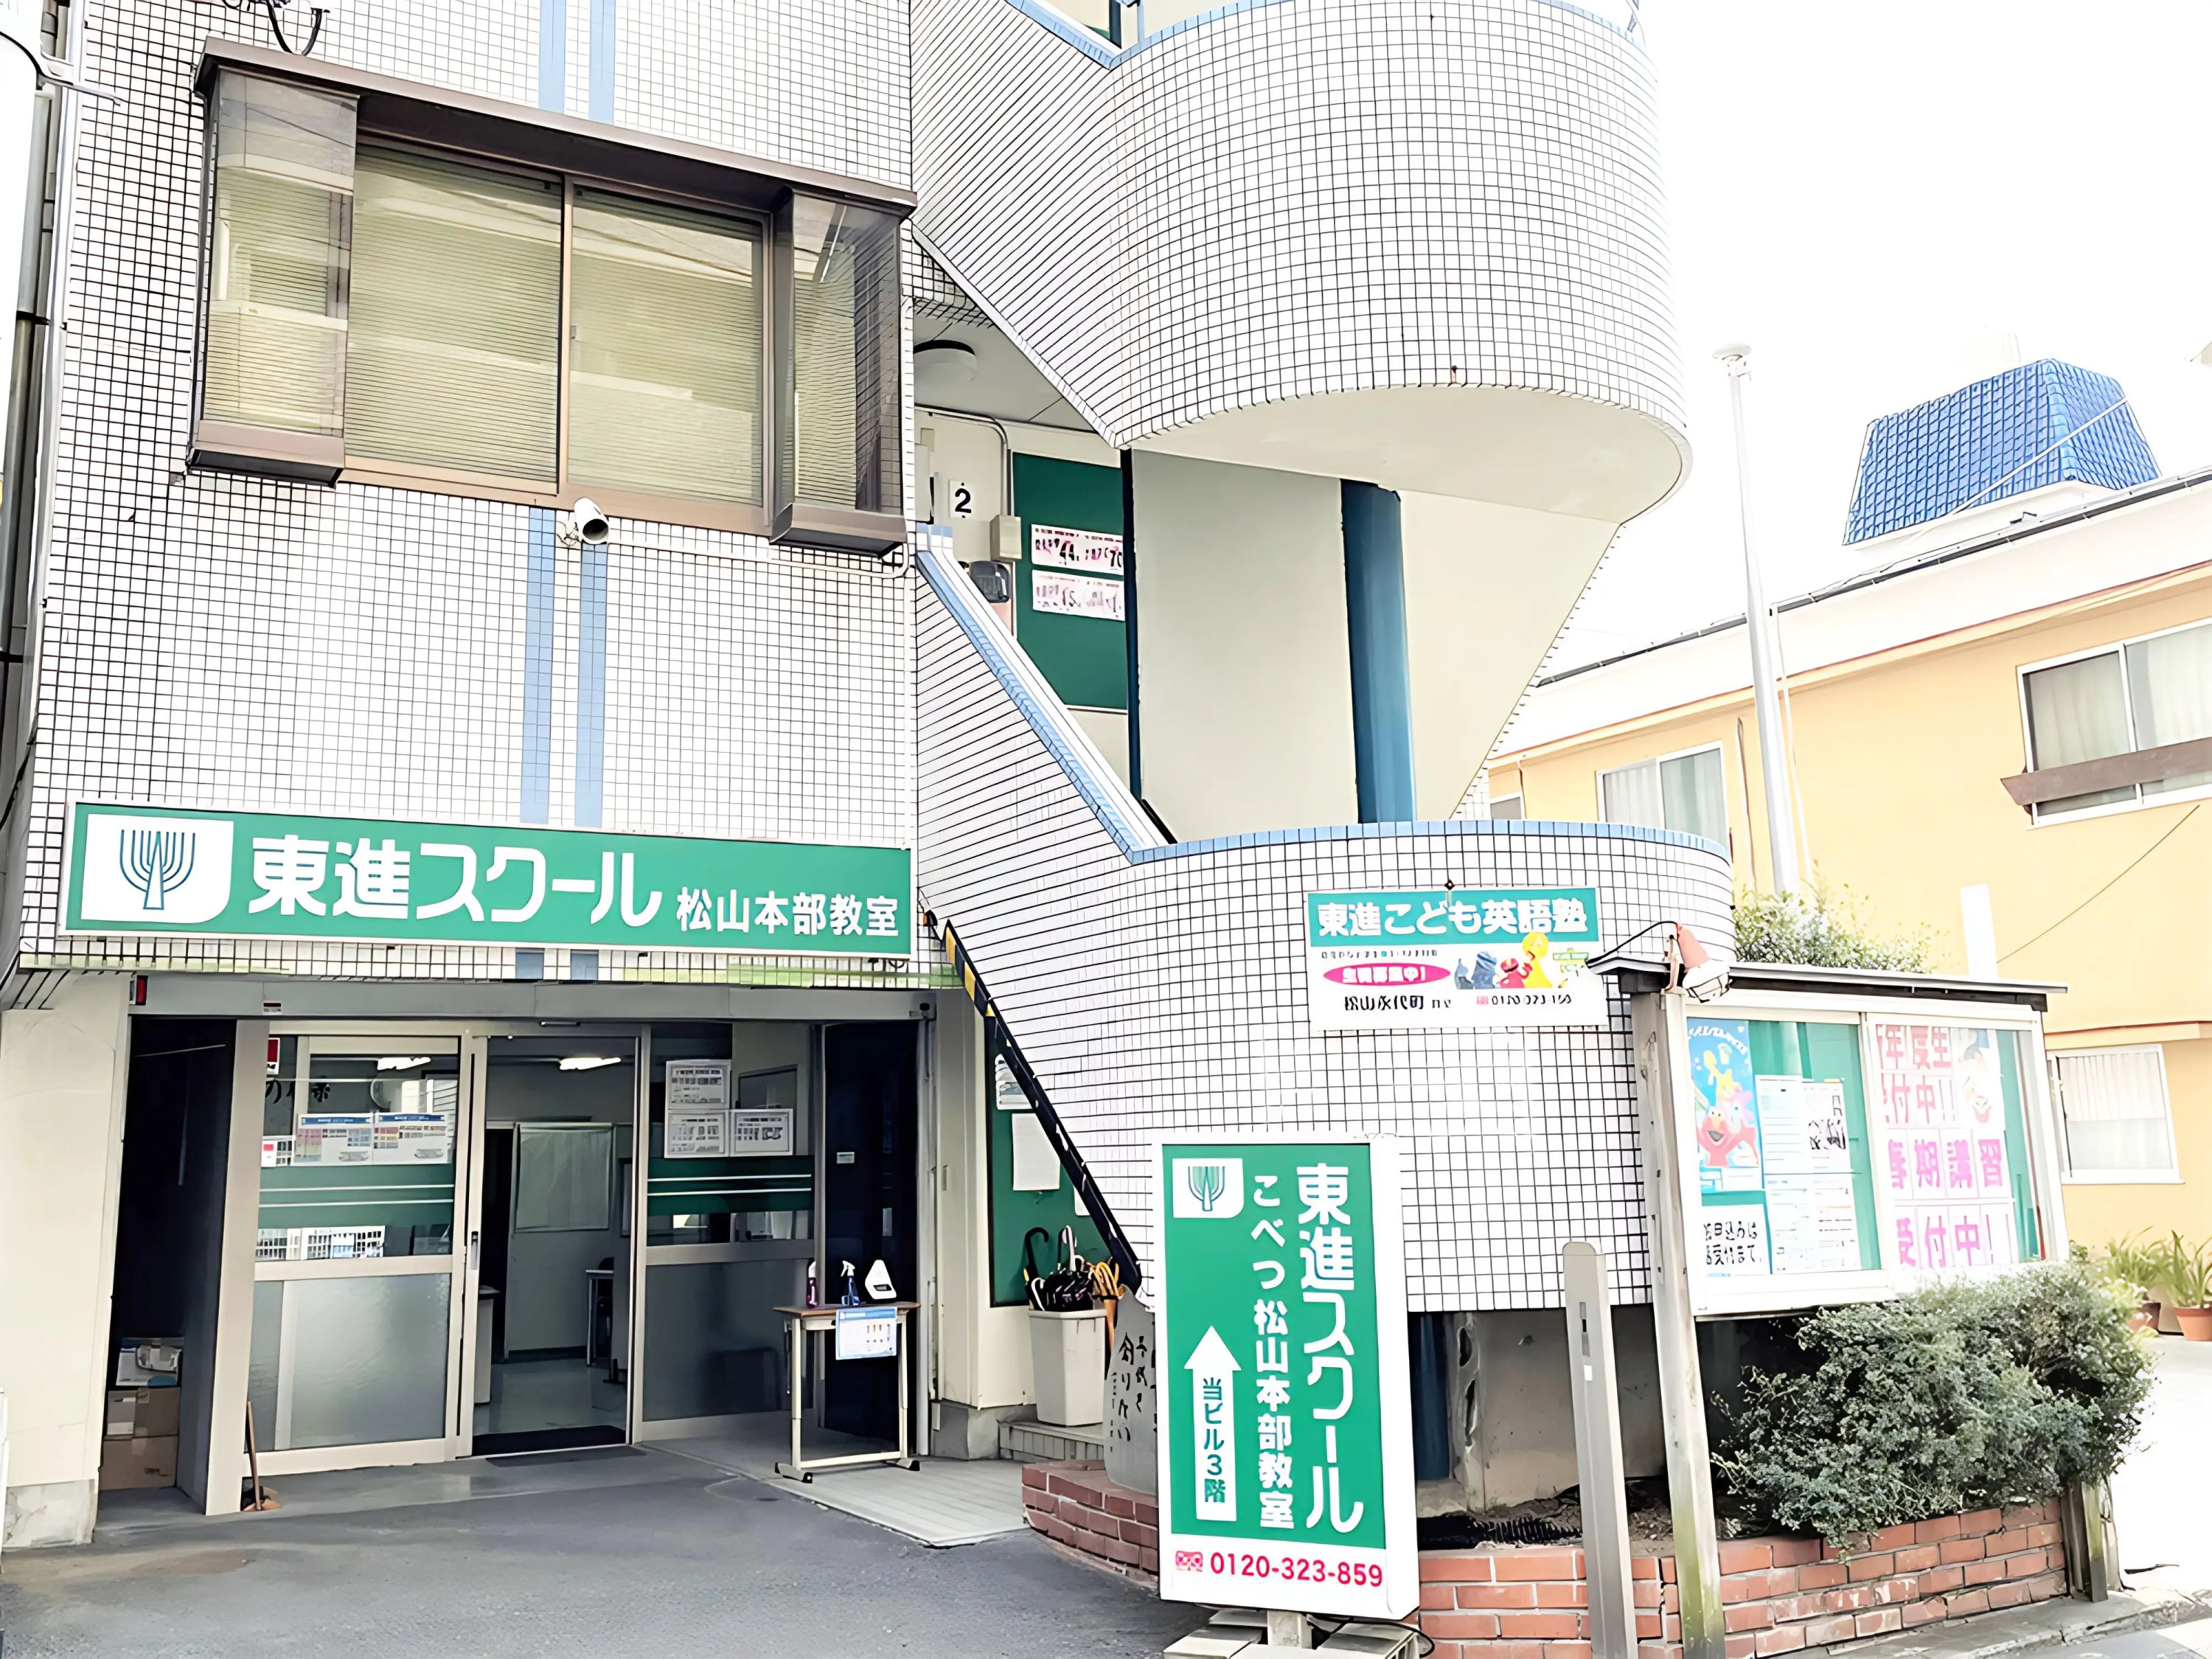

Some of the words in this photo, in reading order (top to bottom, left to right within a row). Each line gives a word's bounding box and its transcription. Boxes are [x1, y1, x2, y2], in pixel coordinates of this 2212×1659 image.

[955, 488, 972, 513] 2
[248, 835, 662, 927] 東進スクール
[676, 886, 899, 936] 松山本部教室
[1318, 897, 1587, 936] 東進こども英語塾
[1296, 1163, 1364, 1534] 東進スクール
[1203, 1377, 1226, 1503] 当ビル3階
[1210, 1551, 1382, 1587] 0120-323-859
